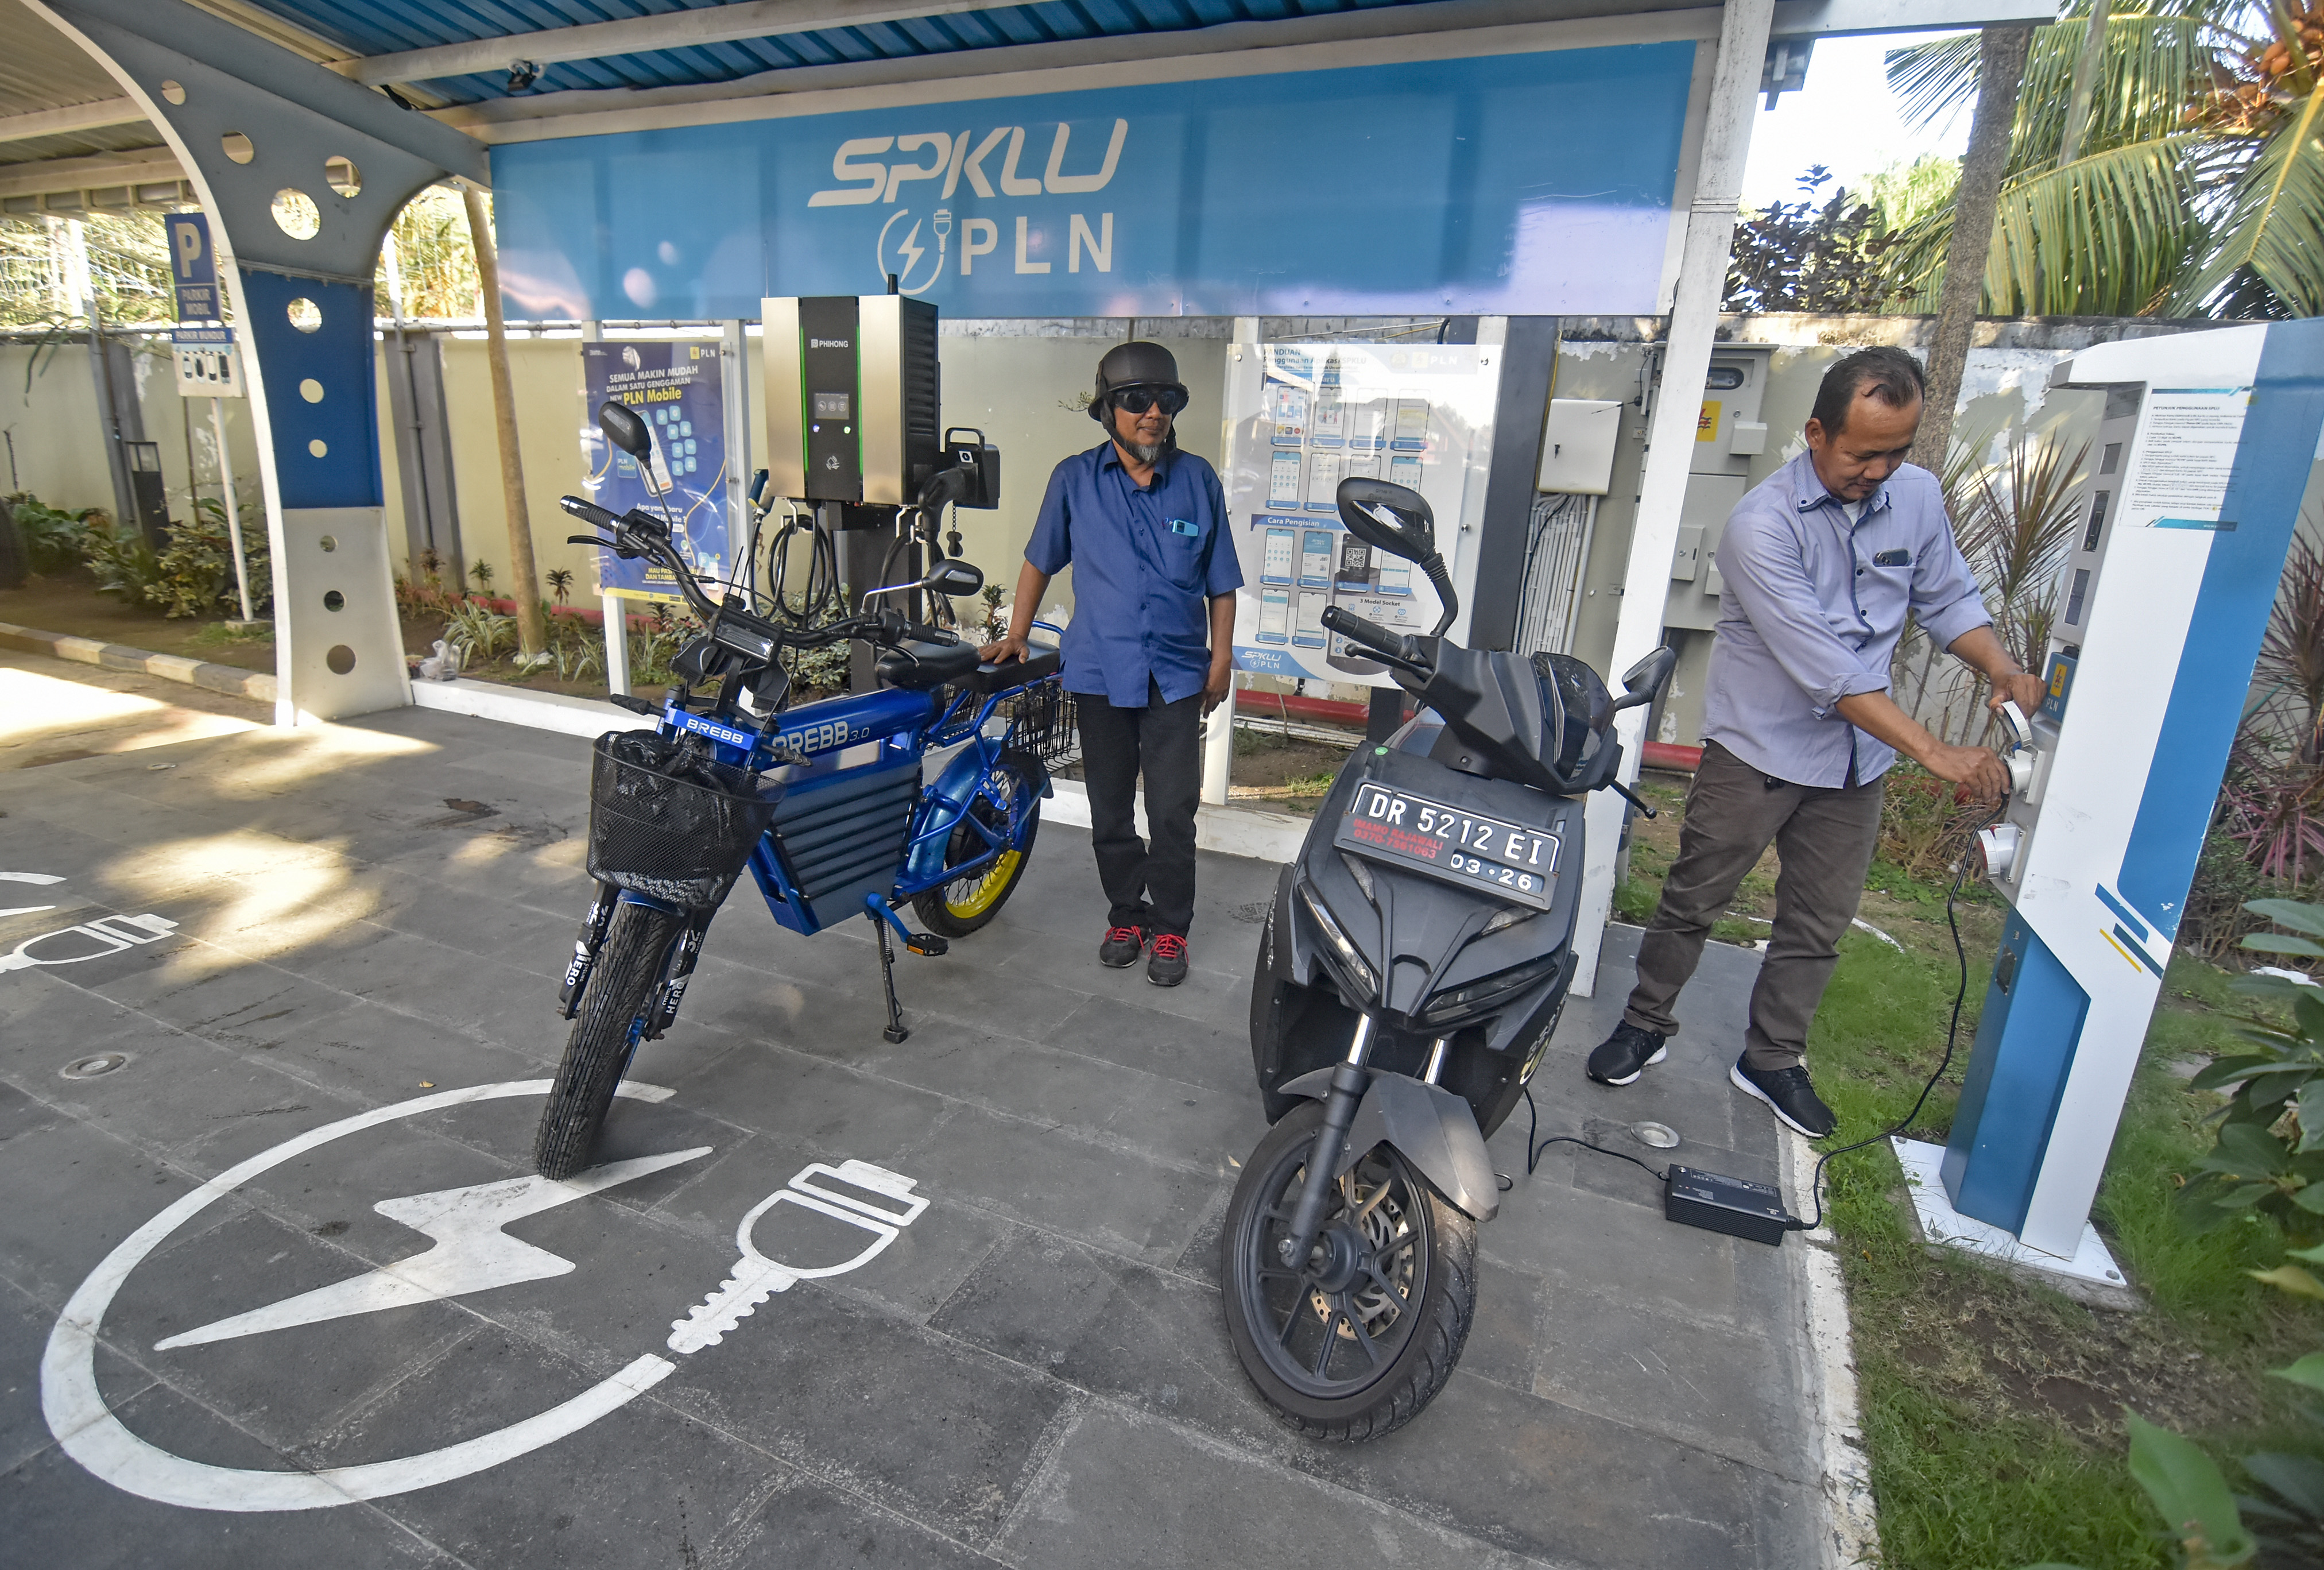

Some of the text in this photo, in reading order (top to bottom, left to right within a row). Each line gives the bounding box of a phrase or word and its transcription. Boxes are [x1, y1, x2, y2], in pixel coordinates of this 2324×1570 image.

[808, 118, 1128, 207] SPKLU
[175, 222, 202, 277] P
[960, 212, 1113, 275] PLN
[819, 340, 849, 348] PHIHONG
[700, 349, 715, 358] PLN
[1430, 356, 1458, 365] PLN
[609, 365, 698, 383] SEMUA MAKIN MUDAH
[606, 377, 691, 393] DALAM SATU GENGGAMAN
[623, 391, 644, 405] PLN
[647, 386, 681, 403] Mobile
[637, 503, 649, 511] Apa
[1285, 519, 1319, 527] Pengisian
[1241, 651, 1281, 661] SPKLU
[2046, 697, 2059, 712] PLN
[686, 718, 743, 744] BREBB
[850, 727, 870, 741] 3.0
[1369, 793, 1543, 864] DR 5212 EI
[1392, 829, 1443, 851] RAJAWALI
[579, 963, 589, 983] CYCLING
[662, 988, 671, 1006] CYCLING
[666, 981, 684, 1014] HERO
